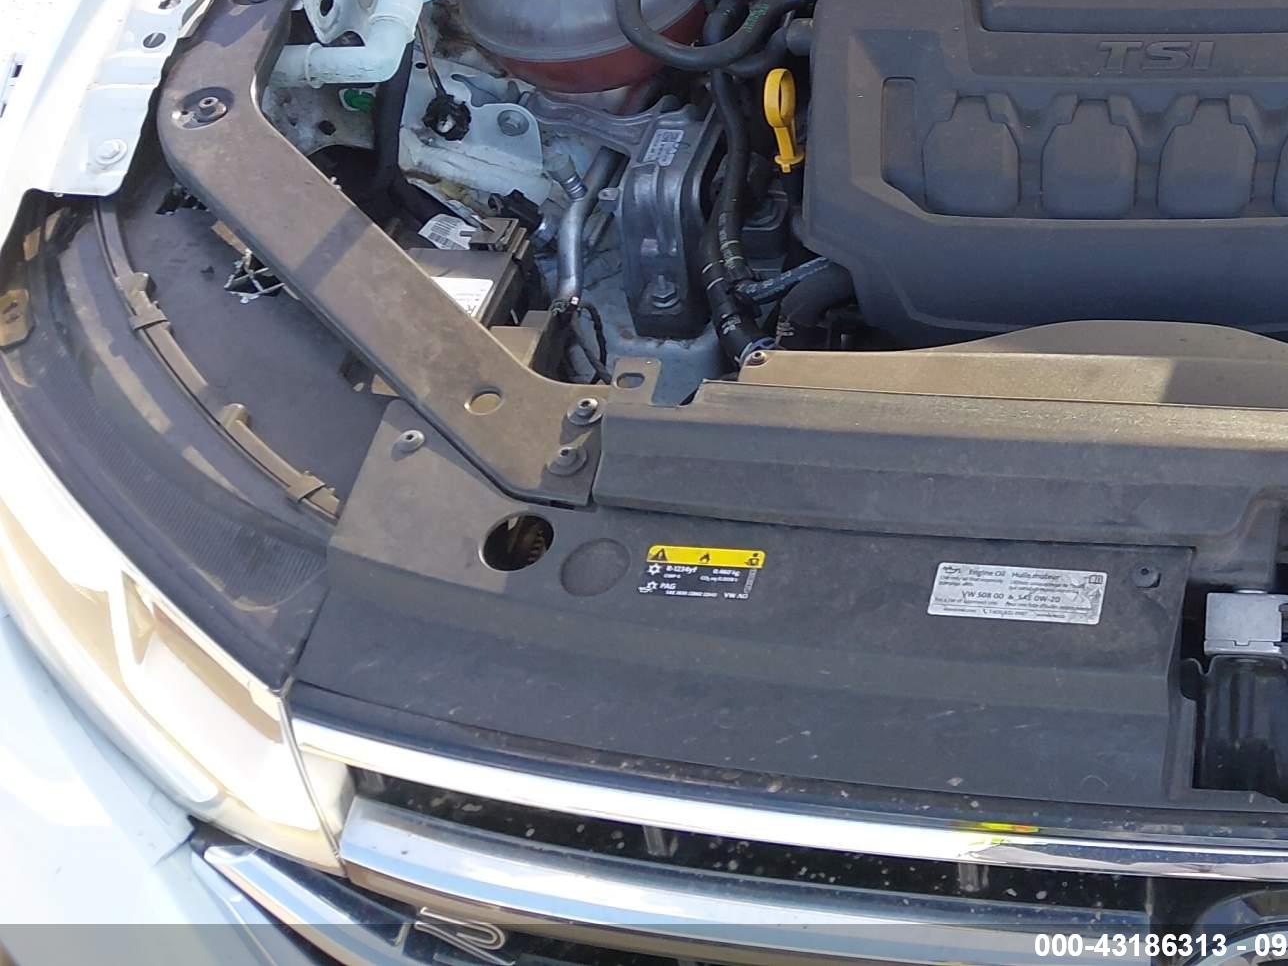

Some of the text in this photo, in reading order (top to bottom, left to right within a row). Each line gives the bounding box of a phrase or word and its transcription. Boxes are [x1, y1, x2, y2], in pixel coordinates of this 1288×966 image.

[1096, 39, 1217, 73] TSI
[968, 569, 993, 577] Engine
[659, 582, 677, 590] PAG
